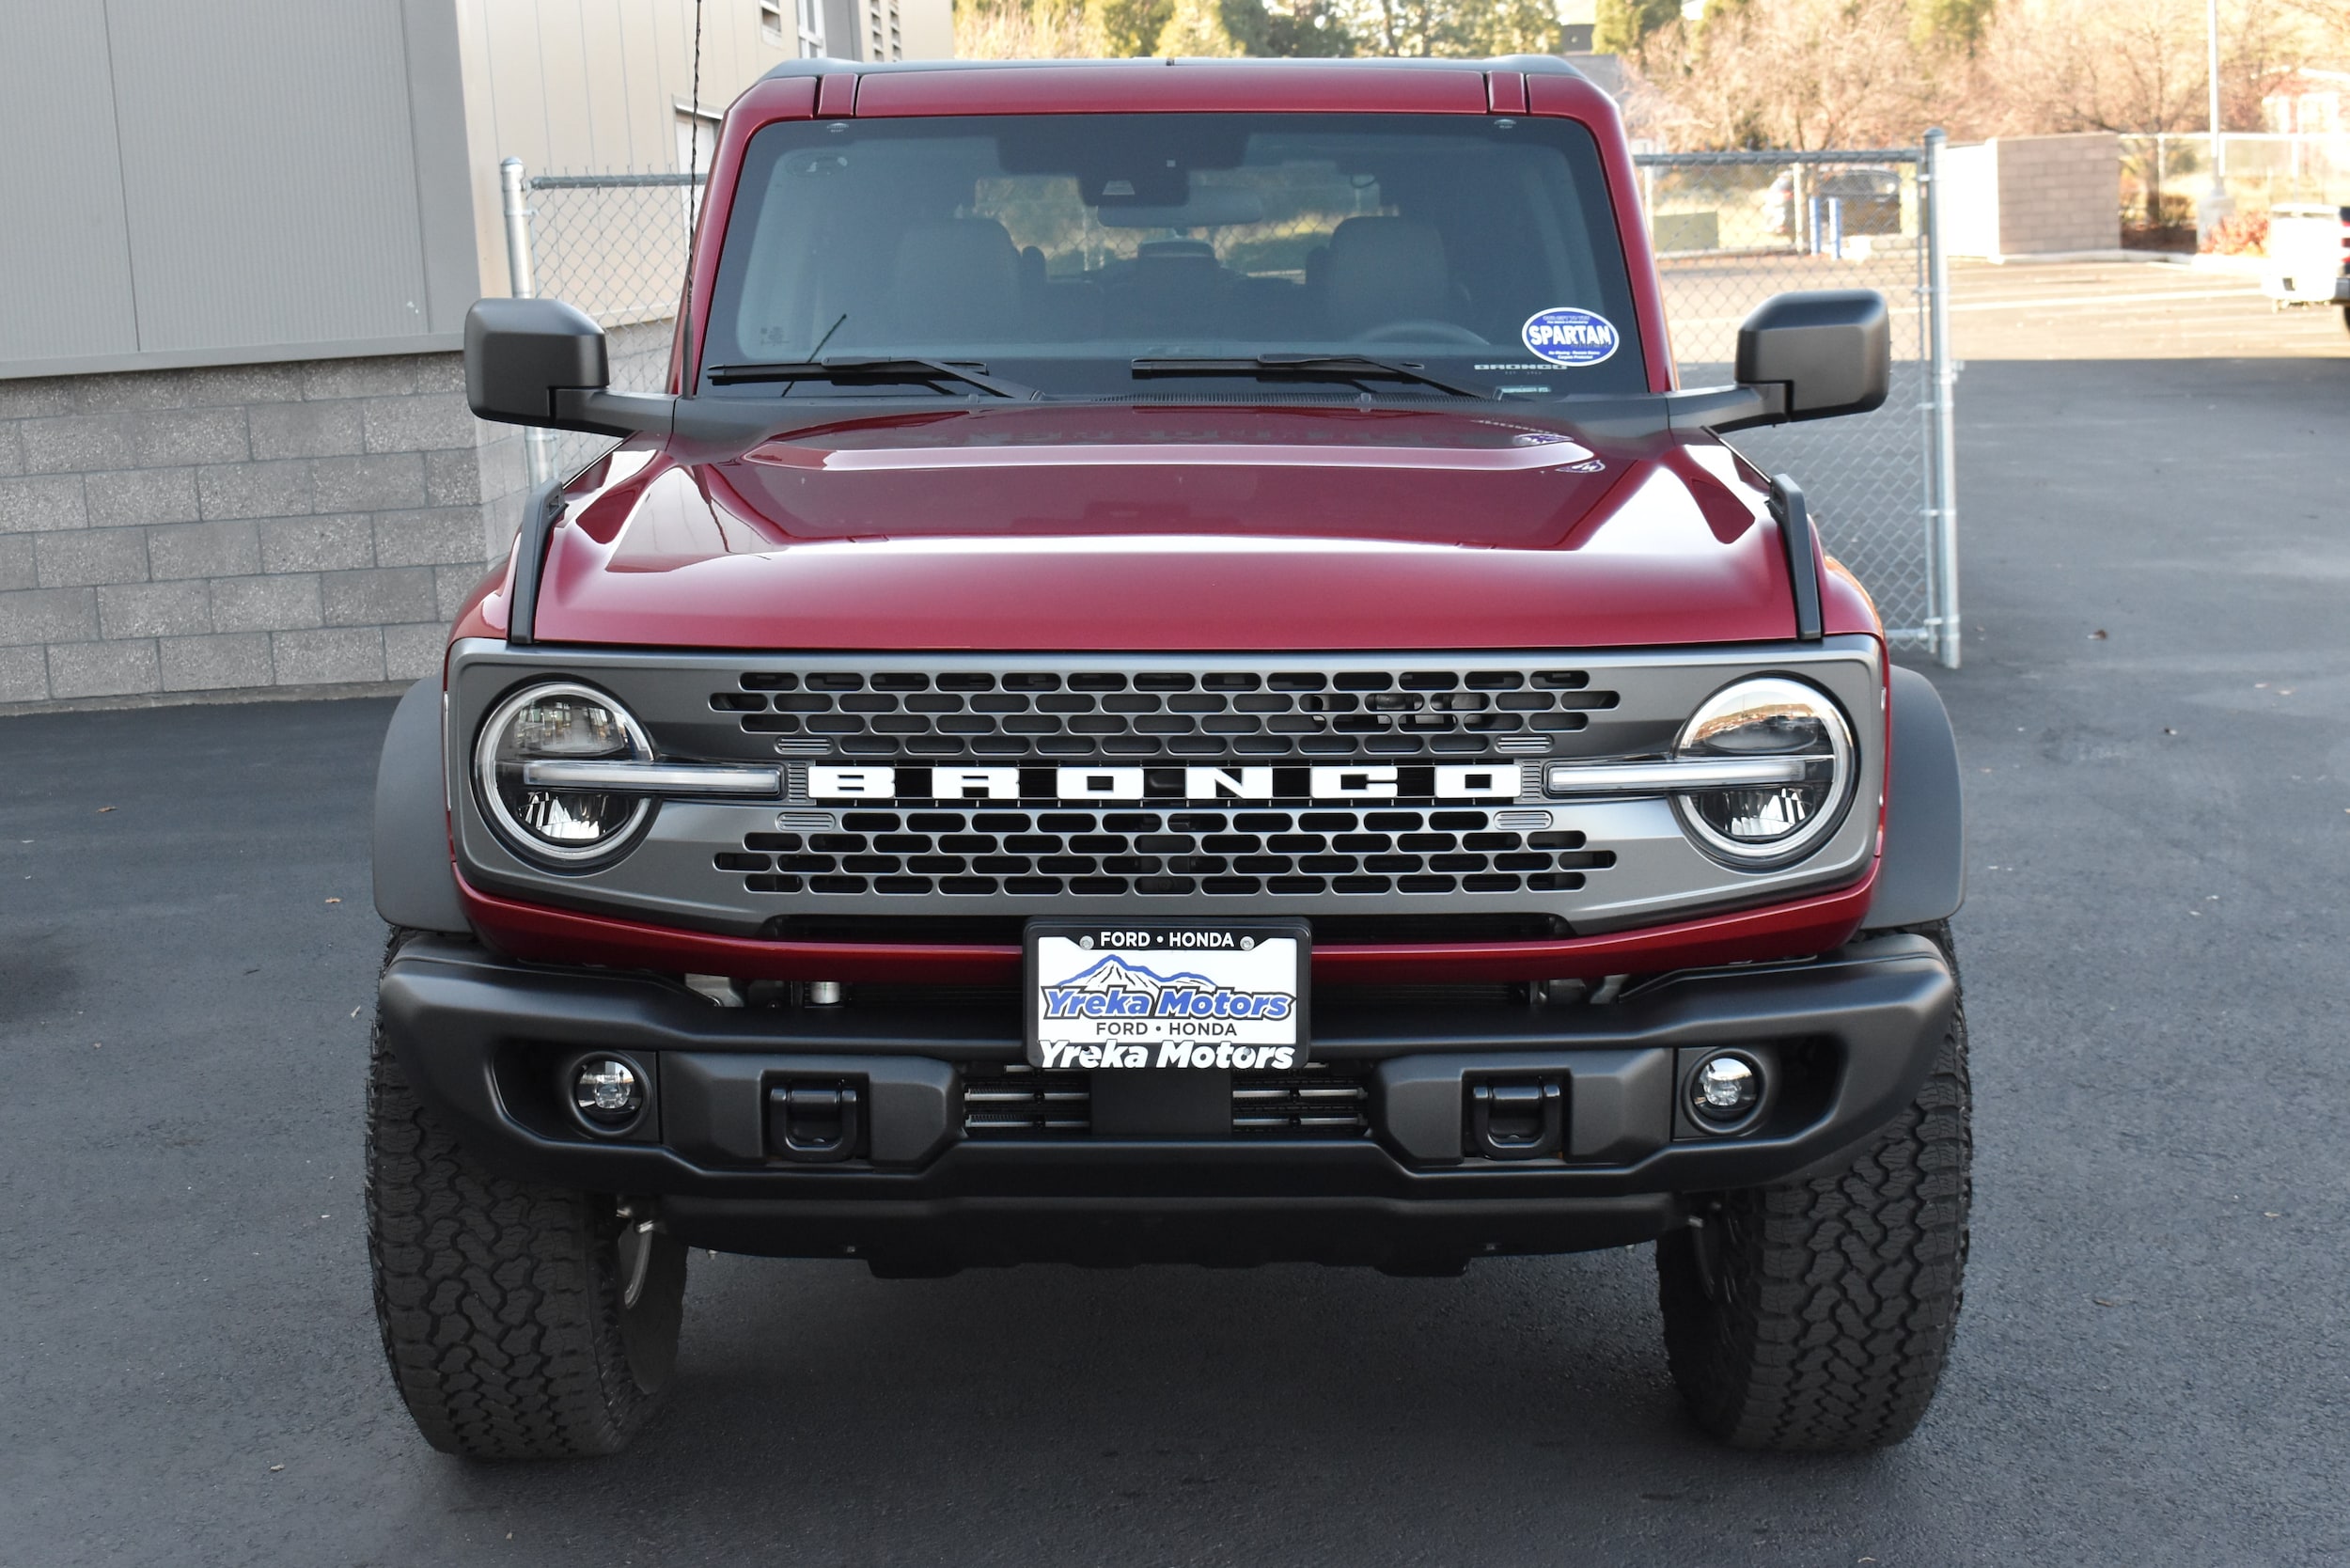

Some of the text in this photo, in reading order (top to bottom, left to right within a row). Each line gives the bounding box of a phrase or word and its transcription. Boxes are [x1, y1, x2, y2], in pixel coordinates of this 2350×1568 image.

[1528, 324, 1612, 345] SPARTAN
[807, 765, 1521, 799] BRONCO
[1100, 932, 1234, 948] FORD HONDA
[1046, 989, 1291, 1016] Yreka Motors
[1096, 1022, 1237, 1036] FORD HONDA
[1039, 1039, 1295, 1070] Yreka Motors
